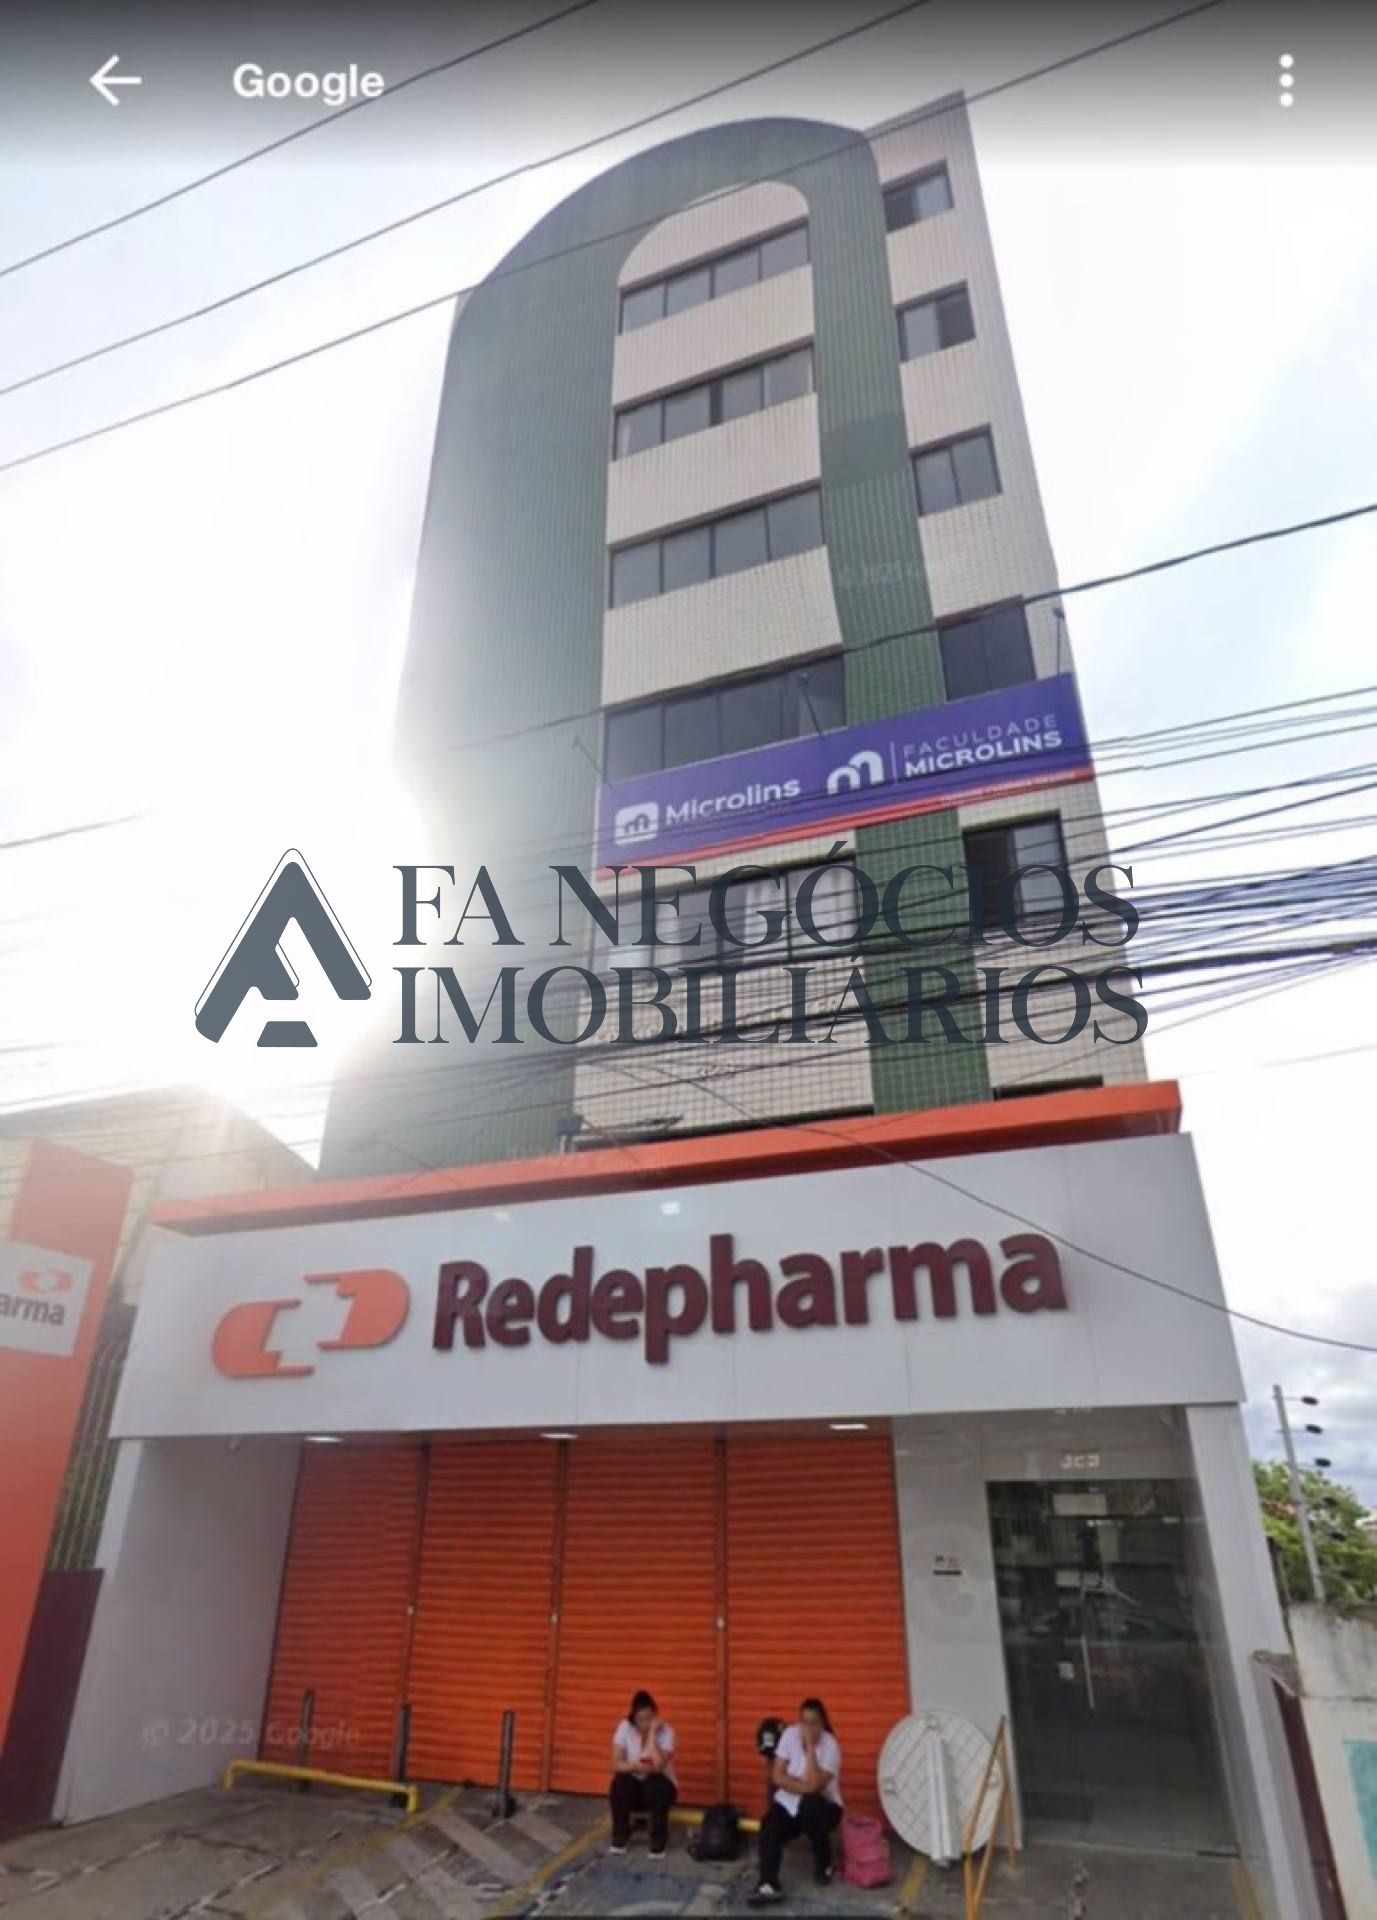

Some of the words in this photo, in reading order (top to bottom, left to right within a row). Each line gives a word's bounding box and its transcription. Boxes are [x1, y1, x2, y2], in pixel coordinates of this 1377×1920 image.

[903, 713, 1058, 760] FACULDADE
[905, 730, 1063, 778] MICROLINS
[665, 778, 802, 826] Microlins
[432, 1233, 1070, 1364] Redepharma
